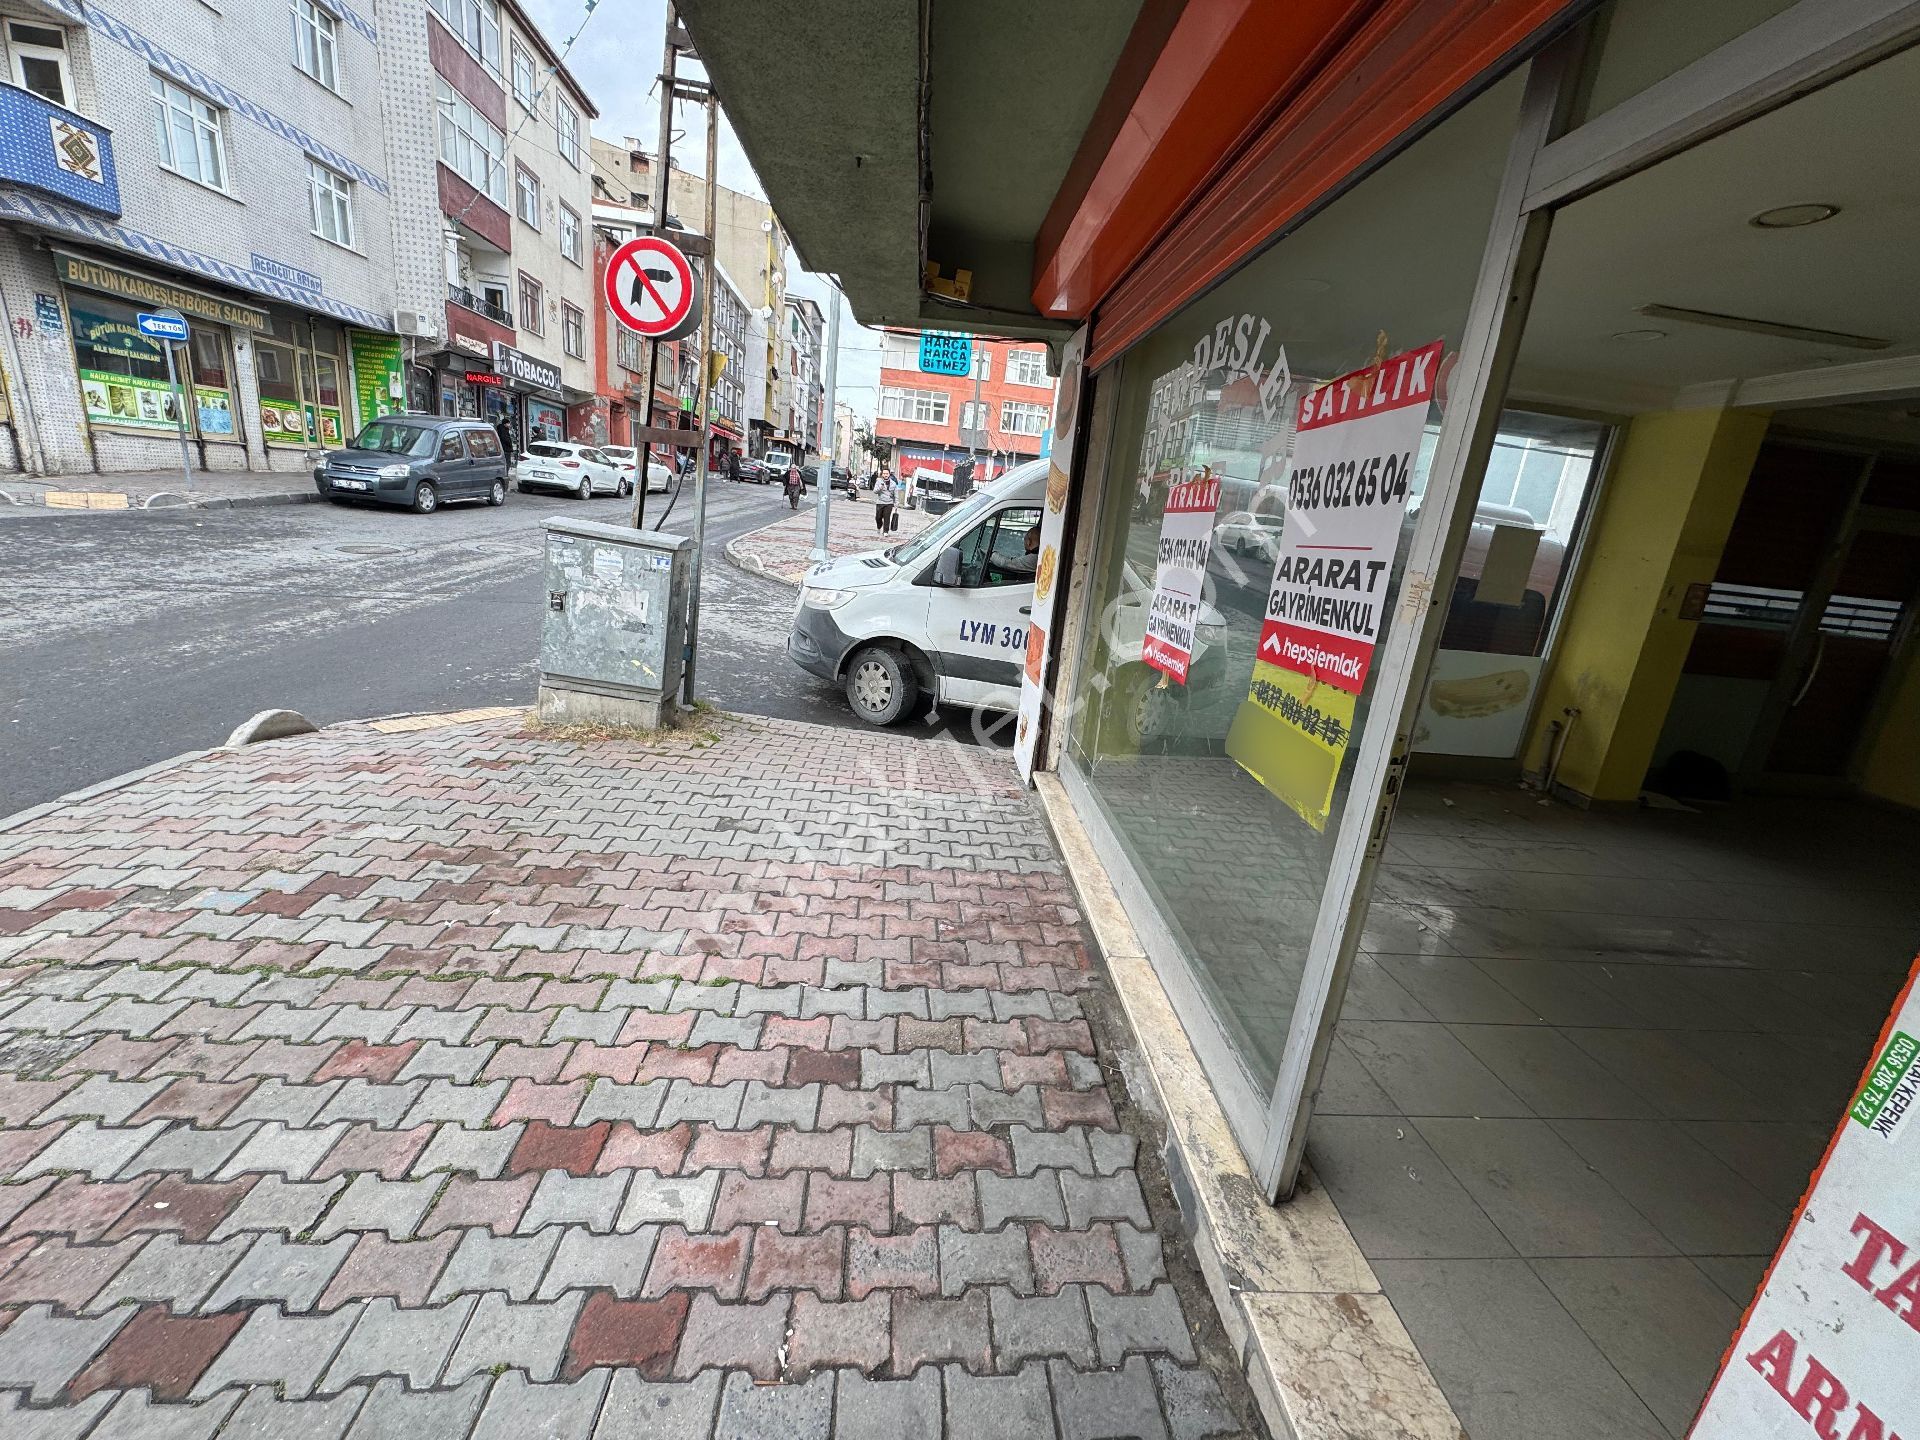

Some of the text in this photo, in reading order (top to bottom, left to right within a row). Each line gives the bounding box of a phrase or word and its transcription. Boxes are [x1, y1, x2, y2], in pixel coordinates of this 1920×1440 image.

[68, 260, 265, 330] BÜTÜN KARDEŞLER BÖREK SALONU
[152, 322, 167, 331] TEK
[924, 336, 968, 351] HARCA
[510, 355, 555, 388] TOBACCO
[924, 347, 967, 361] HARCA
[1301, 350, 1435, 424] SATILIK
[1288, 451, 1411, 510] 0536 032 65 04
[1276, 556, 1387, 593] ARARAT
[1152, 593, 1196, 623] ARARAT
[1269, 585, 1375, 637] GAYRİMENKUL
[959, 619, 1029, 651] LYM 30
[1152, 648, 1186, 677] hepsiemlak
[1282, 637, 1363, 681] hepsiemlak
[1853, 1037, 1916, 1121] 0536 206 75 22
[1870, 1083, 1917, 1140] KEPENK
